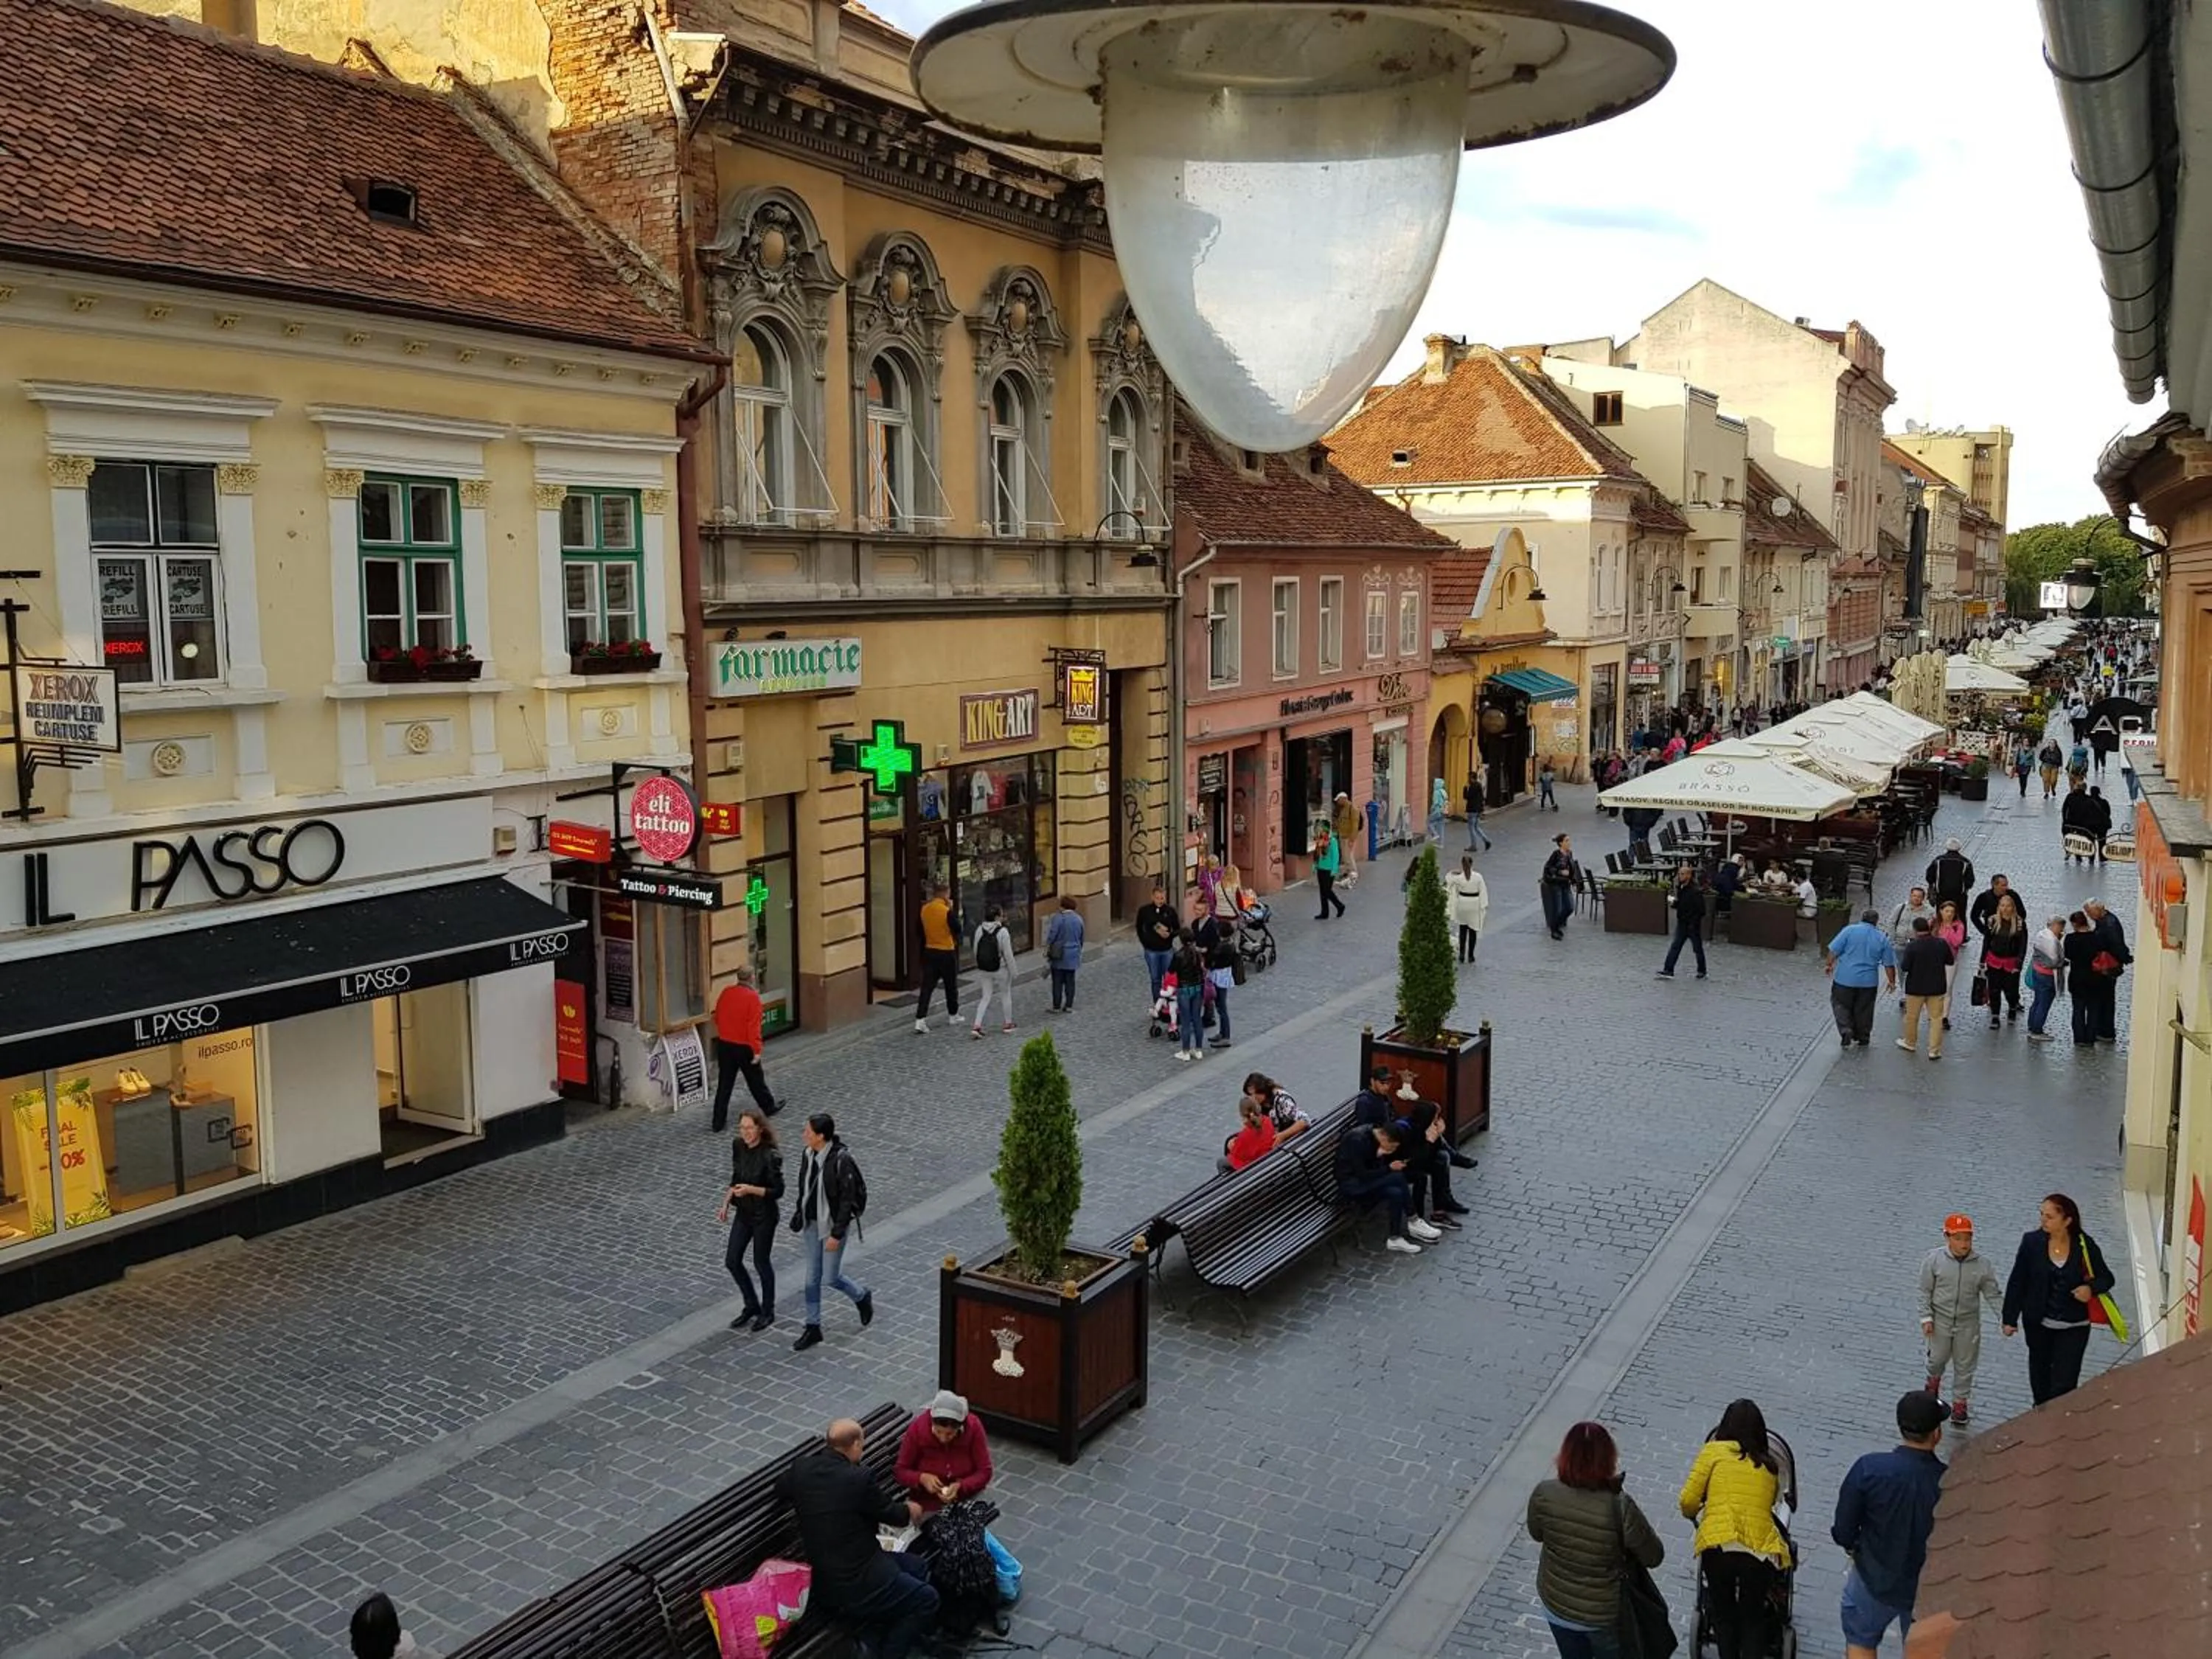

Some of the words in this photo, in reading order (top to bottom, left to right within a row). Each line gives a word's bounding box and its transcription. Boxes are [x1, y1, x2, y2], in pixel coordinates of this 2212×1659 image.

[99, 566, 135, 576] REFILL
[167, 566, 203, 577] CARTUSE
[102, 604, 138, 615] REFILL
[170, 604, 205, 614] CARTUSE
[105, 641, 143, 654] XEROX
[720, 640, 860, 685] farmacie
[29, 672, 100, 703] XEROX
[1071, 683, 1093, 704] KING
[966, 698, 1006, 743] KING
[1005, 694, 1033, 737] ART
[1071, 704, 1093, 717] ART
[34, 720, 98, 742] CARTUSE
[648, 793, 671, 813] eli
[635, 812, 690, 834] tattoo
[24, 852, 76, 927] IL
[131, 819, 345, 912] PASSO
[621, 878, 657, 894] Tattoo
[667, 885, 714, 905] Piercing
[509, 943, 521, 961] IL
[523, 933, 568, 959] PASSO
[341, 977, 354, 998] IL
[355, 965, 411, 994] PASSO
[135, 1018, 151, 1041] IL
[153, 1004, 220, 1037] PASSO
[198, 1037, 254, 1060] ilpasso.ro
[41, 1120, 77, 1139] FAL
[44, 1133, 77, 1152] SLE
